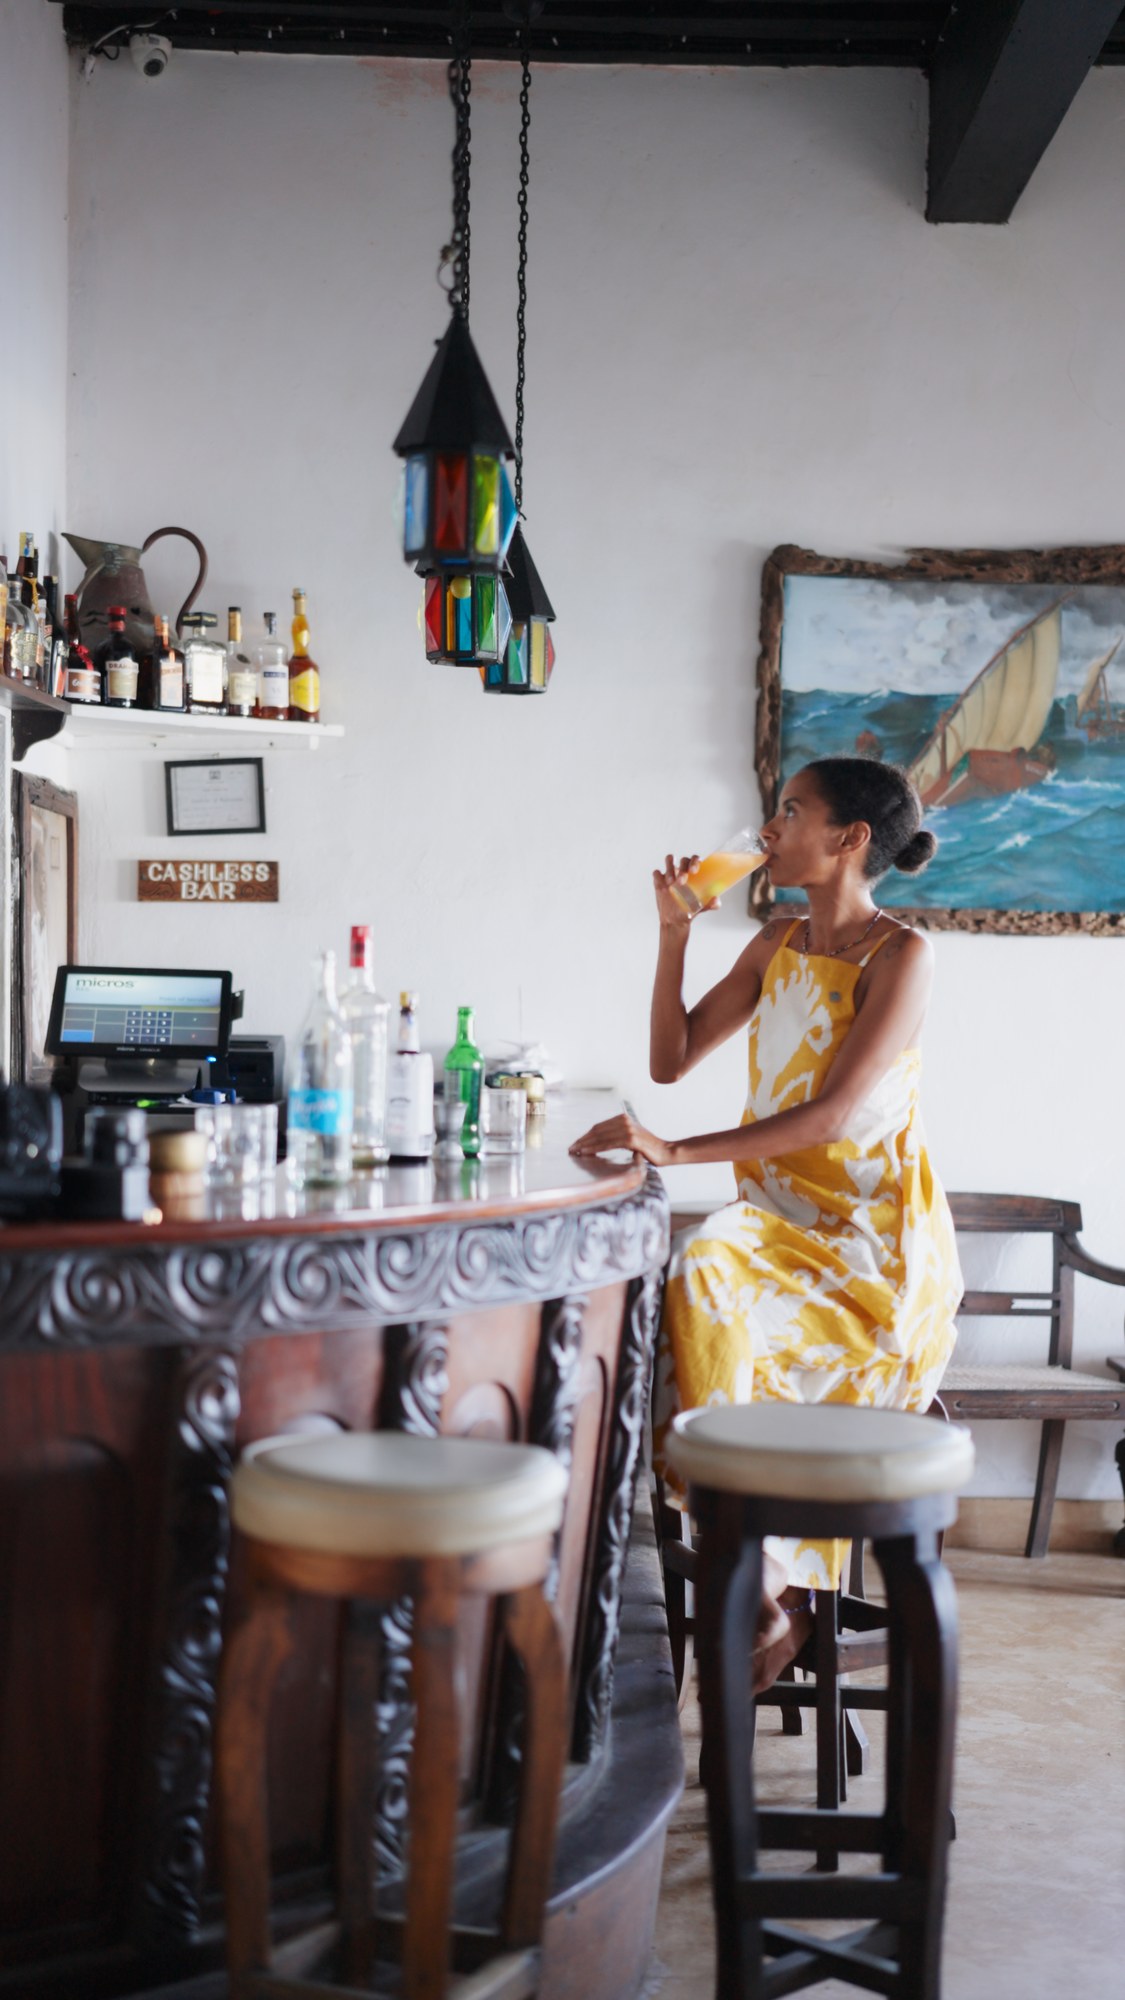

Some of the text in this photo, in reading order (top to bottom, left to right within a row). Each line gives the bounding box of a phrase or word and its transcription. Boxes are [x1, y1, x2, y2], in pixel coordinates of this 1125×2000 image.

[148, 862, 270, 882] CASHLESS
[181, 881, 236, 900] BAR
[76, 977, 135, 988] micros
